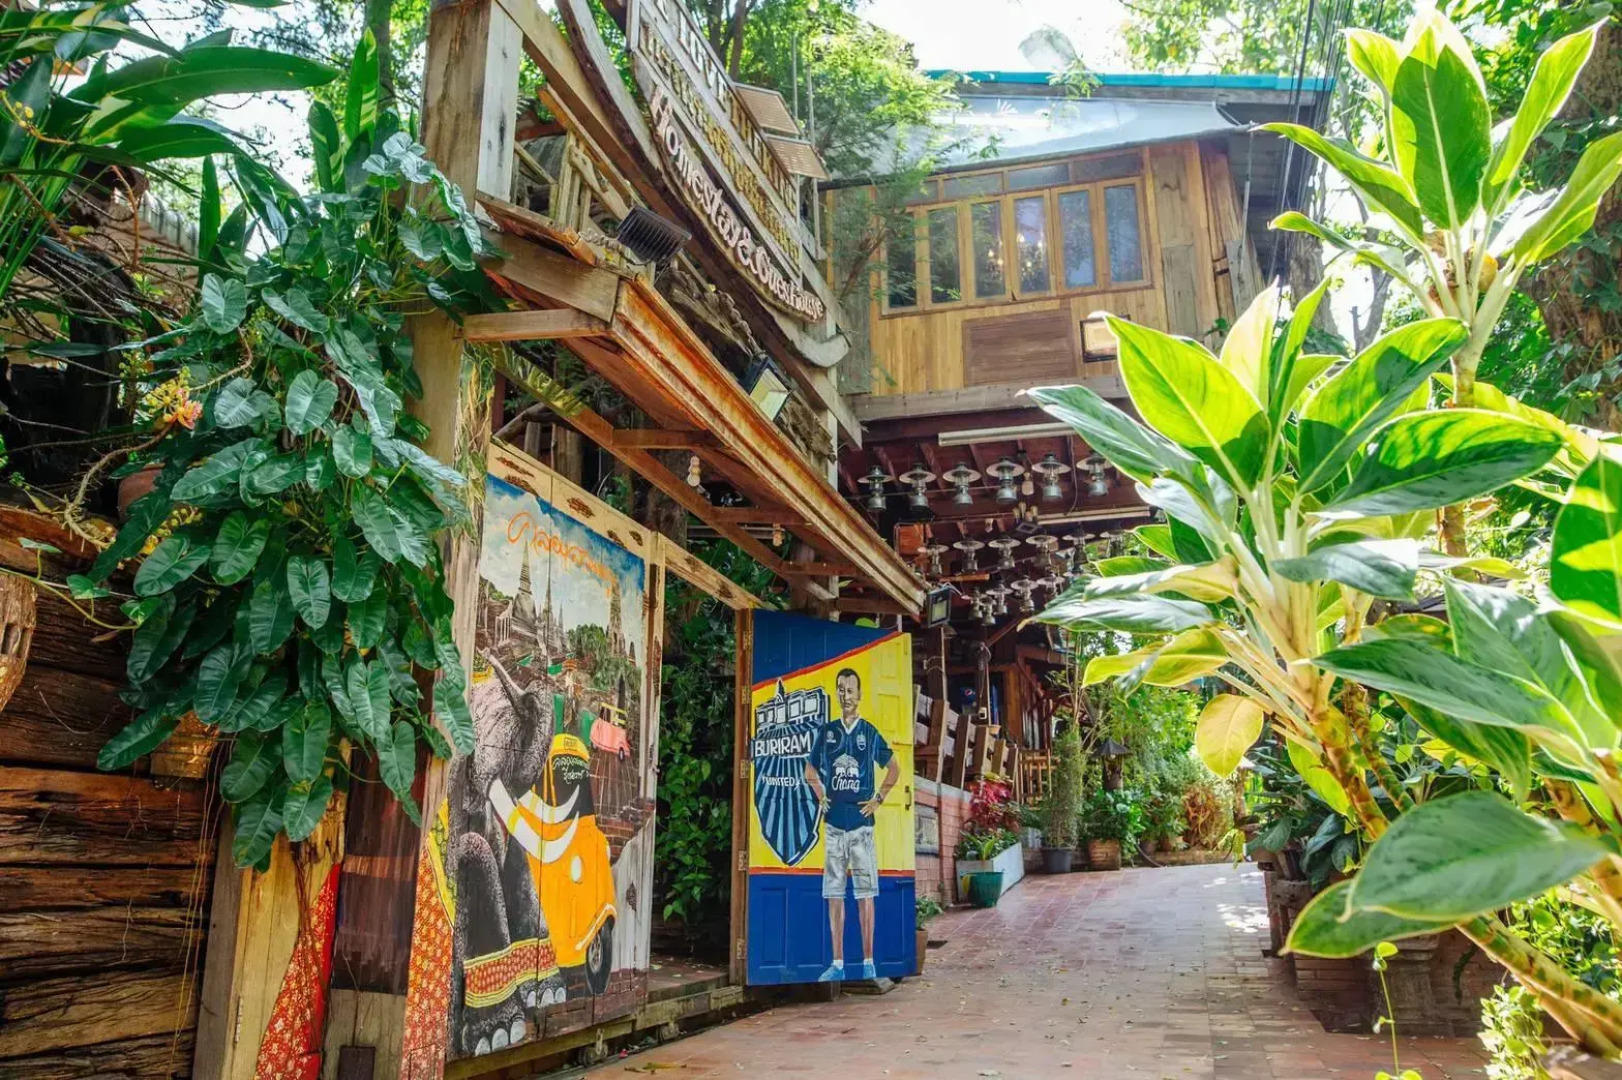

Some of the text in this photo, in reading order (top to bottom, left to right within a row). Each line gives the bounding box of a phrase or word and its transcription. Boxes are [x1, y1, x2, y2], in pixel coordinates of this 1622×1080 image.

[679, 10, 731, 113] LOVE
[755, 731, 811, 757] BURIRAM
[766, 776, 795, 787] UNITED
[832, 773, 860, 793] Chang
